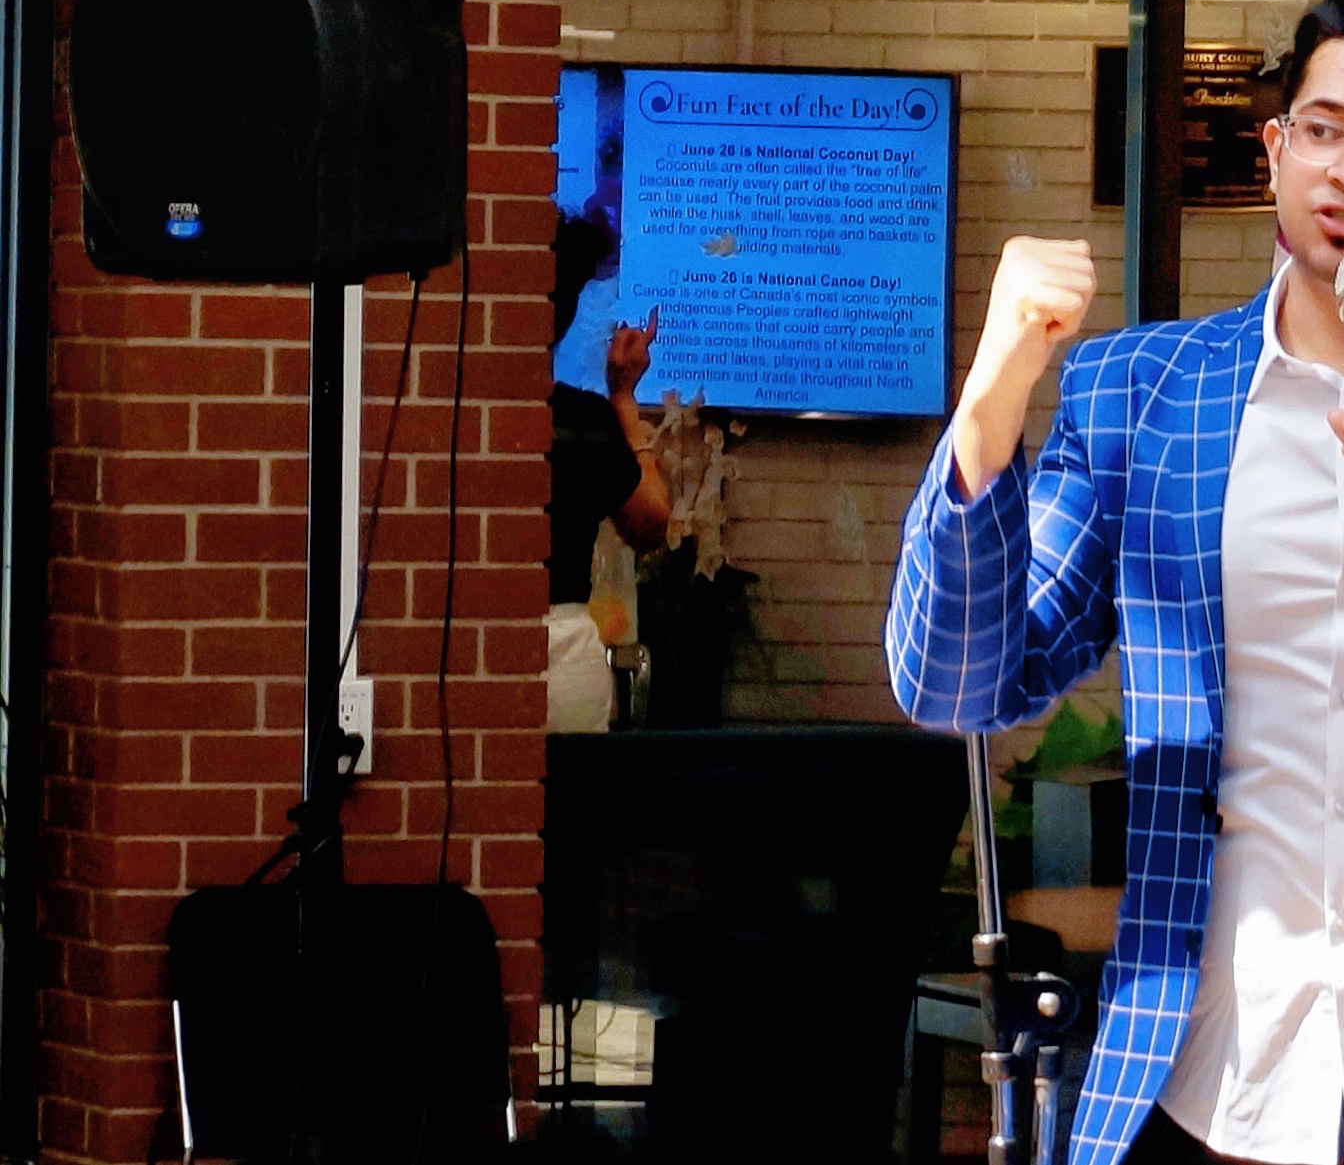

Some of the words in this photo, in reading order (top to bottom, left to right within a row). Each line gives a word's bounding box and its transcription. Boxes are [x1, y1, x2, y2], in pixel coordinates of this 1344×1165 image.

[677, 93, 717, 114] Fun
[727, 94, 772, 116] Fact
[780, 93, 805, 116] of
[809, 94, 844, 118] the
[852, 98, 900, 128] Day!
[681, 143, 715, 156] June
[740, 145, 752, 157] is
[756, 145, 814, 159] National
[819, 147, 878, 161] Coconut
[884, 148, 915, 164] Day!
[721, 163, 742, 173] are
[746, 161, 780, 174] often
[784, 163, 822, 176] called
[827, 163, 847, 176] the
[886, 165, 899, 178] of
[639, 175, 695, 187] because
[699, 176, 738, 192] nearly
[743, 179, 779, 192] every
[784, 179, 809, 192] part
[813, 180, 825, 191] of
[829, 180, 849, 192] the
[854, 182, 905, 194] coconut
[910, 183, 942, 196] palm
[638, 191, 661, 202] can
[728, 191, 751, 205] The
[756, 193, 780, 206] fruit
[784, 195, 840, 208] provides
[844, 196, 873, 208] food
[878, 198, 902, 209] and
[650, 206, 682, 218] while
[686, 207, 707, 219] the
[840, 212, 864, 224] and
[869, 214, 904, 226] wood
[908, 216, 929, 226] are
[642, 222, 675, 234] used
[678, 223, 696, 235] for
[772, 225, 801, 238] from
[805, 227, 834, 242] rope
[840, 228, 864, 240] and
[868, 229, 919, 242] baskets
[924, 230, 936, 243] to
[738, 241, 777, 256] uilding
[682, 270, 716, 283] June
[741, 272, 753, 284] is
[758, 272, 816, 286] National
[820, 274, 865, 287] Canoe
[870, 275, 902, 292] Day!
[632, 284, 675, 297] Canoe
[680, 287, 690, 298] is
[694, 289, 719, 299] one
[723, 287, 736, 299] of
[740, 288, 801, 302] Canada's
[806, 291, 837, 303] most
[842, 293, 880, 304] iconic
[661, 300, 732, 315] Indigenous
[737, 303, 789, 318] Peoples
[794, 306, 839, 319] crafted
[843, 308, 913, 323] lightweight
[639, 316, 699, 330] bchbark
[703, 321, 750, 333] canoes
[755, 321, 780, 333] that
[784, 323, 819, 334] could
[824, 324, 855, 336] carry
[860, 324, 905, 339] people
[910, 326, 935, 338] and
[655, 334, 700, 349] upplies
[704, 336, 748, 348] across
[752, 335, 820, 349] thousands
[824, 338, 837, 351] of
[913, 341, 926, 355] of
[702, 351, 727, 364] and
[774, 353, 820, 371] playing
[824, 359, 833, 369] a
[837, 356, 864, 369] vital
[868, 358, 893, 370] role
[896, 359, 909, 371] in
[657, 367, 729, 381] exploration
[733, 370, 758, 383] and
[762, 371, 796, 384] trade
[801, 372, 872, 389] throughout
[877, 375, 914, 389] North
